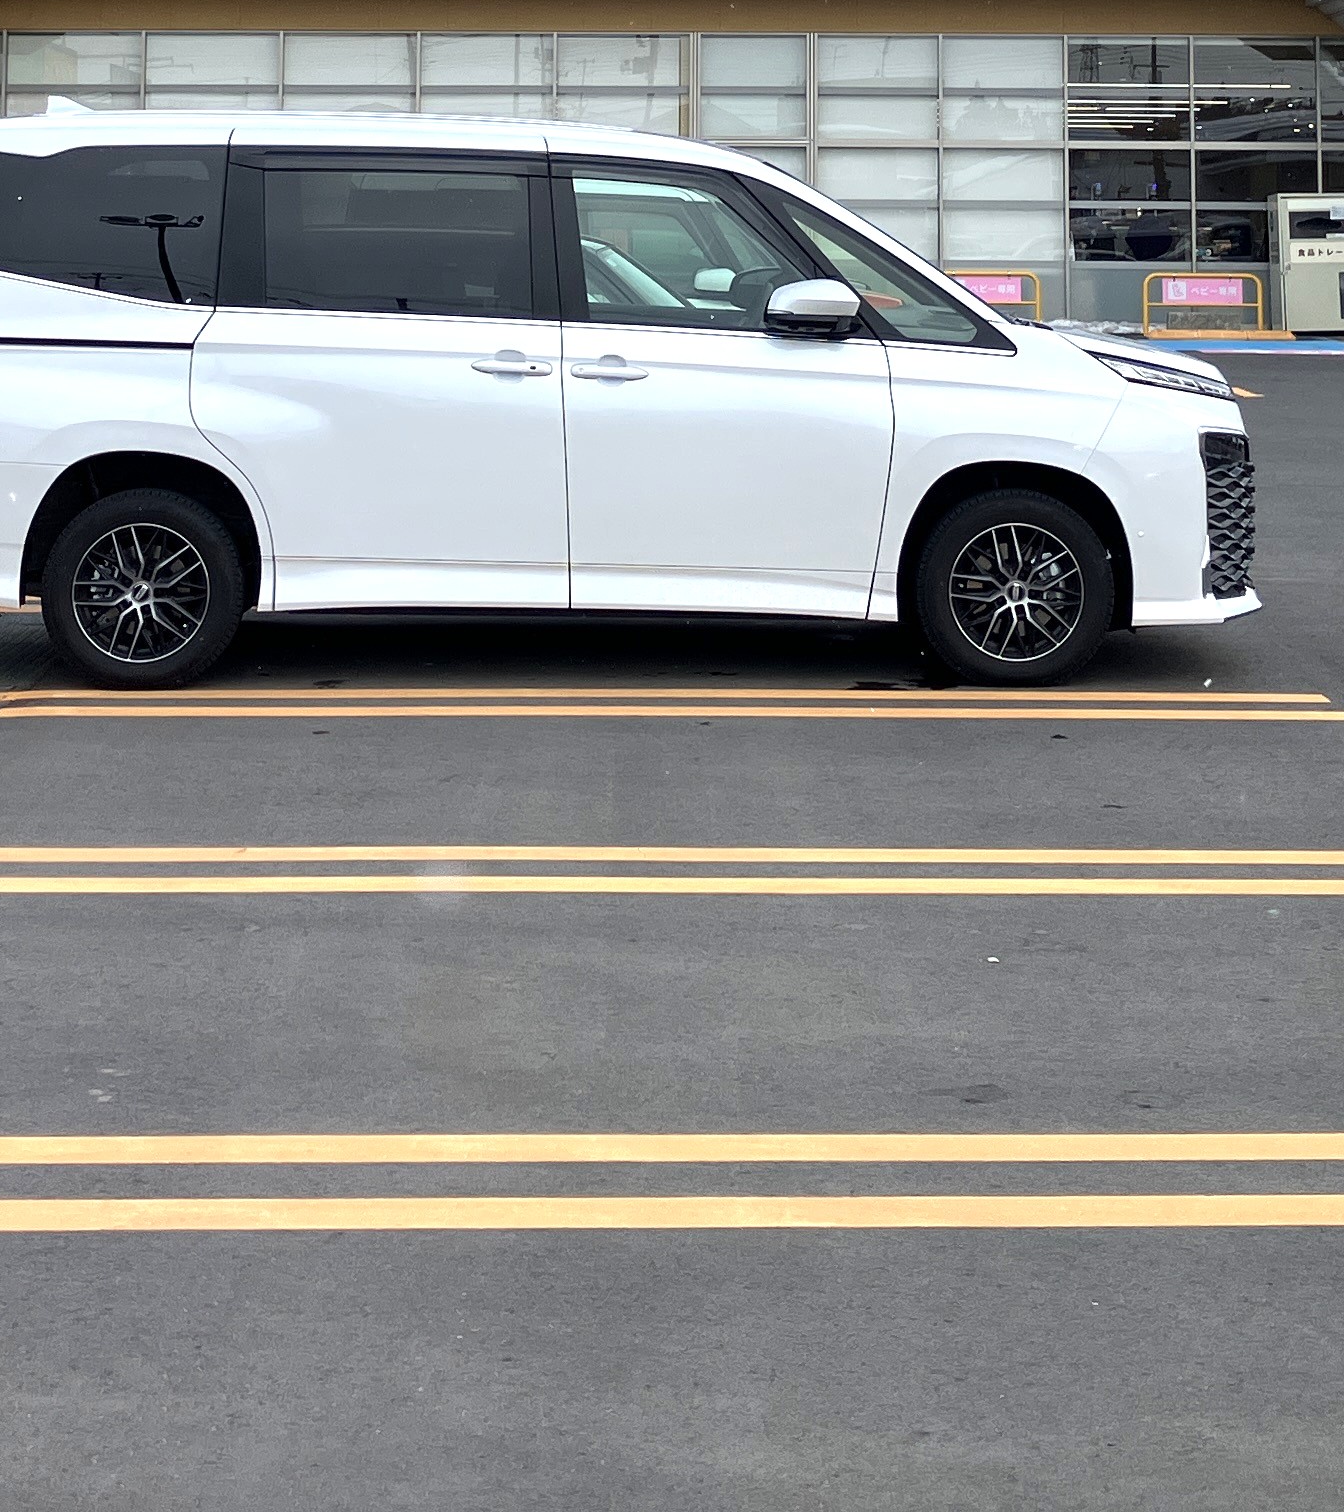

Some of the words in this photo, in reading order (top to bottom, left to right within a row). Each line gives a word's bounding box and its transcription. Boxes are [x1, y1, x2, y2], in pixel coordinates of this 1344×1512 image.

[1297, 248, 1343, 257] 食品トレー
